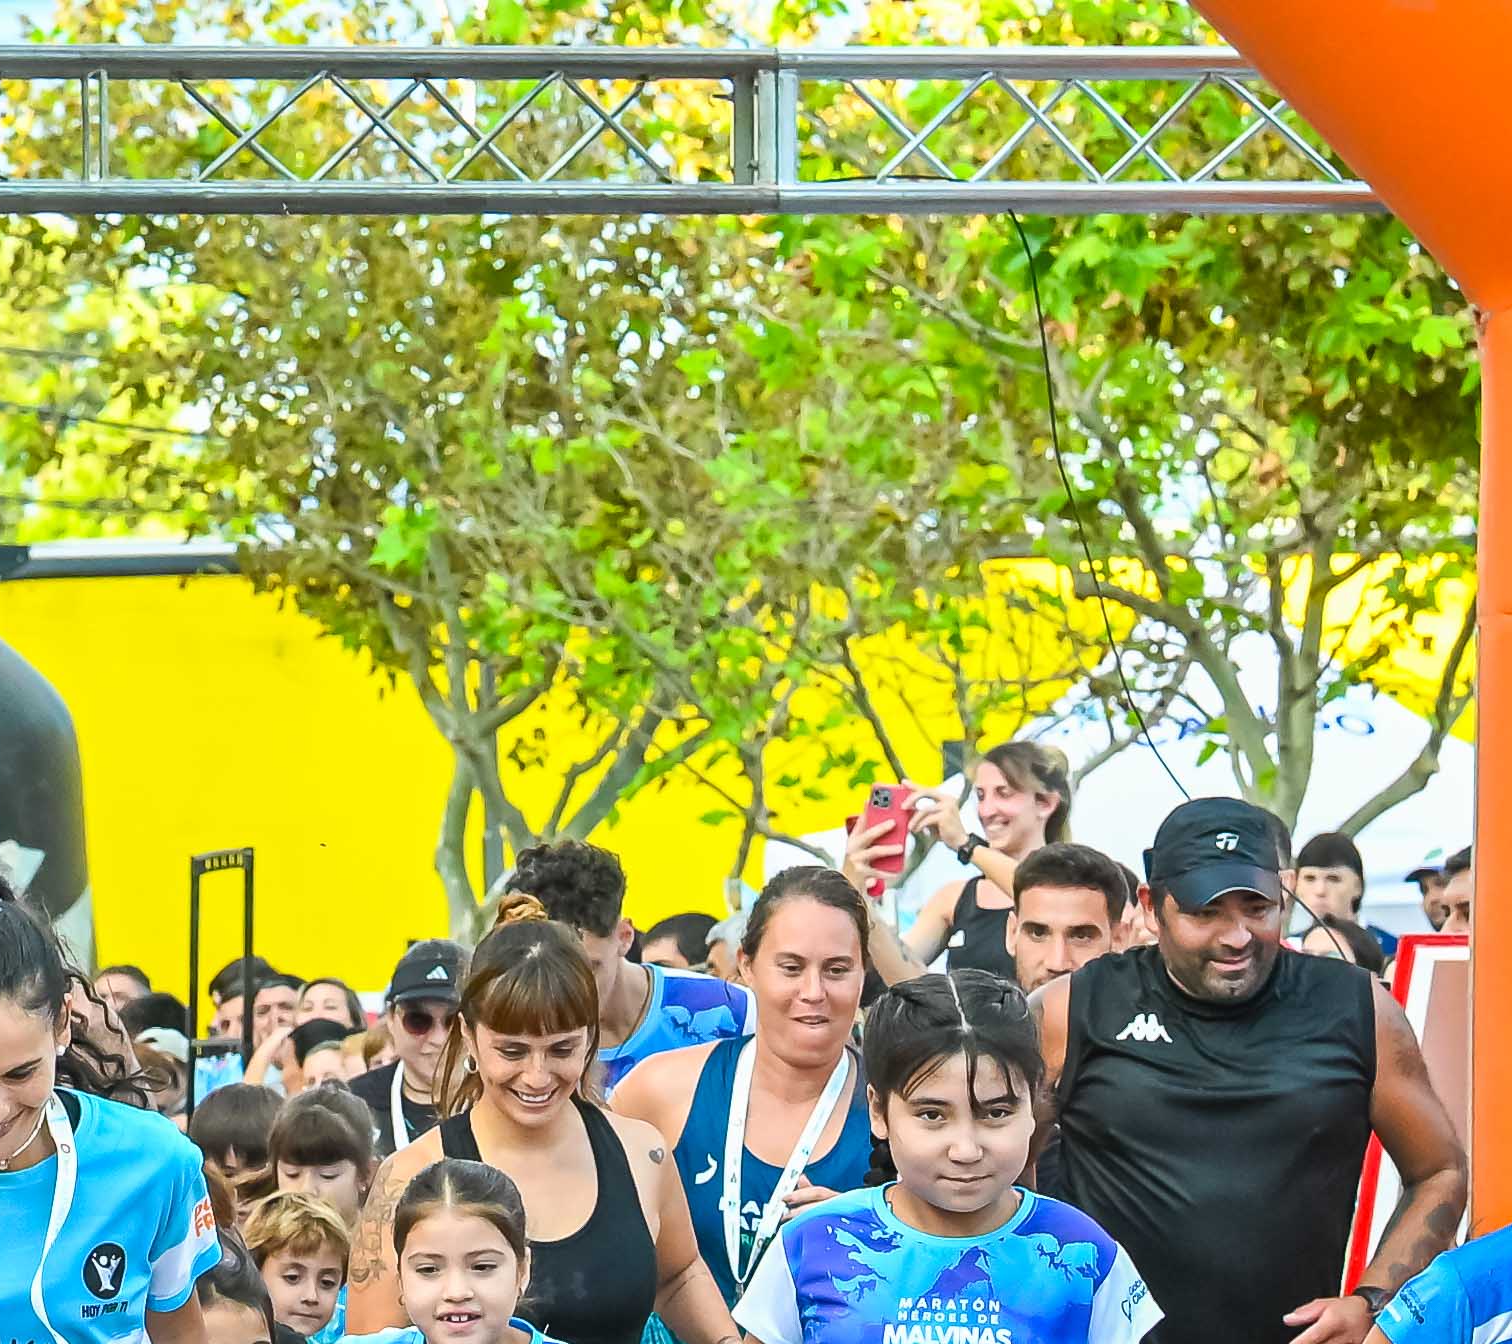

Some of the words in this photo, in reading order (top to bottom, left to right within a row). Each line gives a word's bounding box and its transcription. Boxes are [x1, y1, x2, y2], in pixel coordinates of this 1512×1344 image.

[81, 1303, 101, 1318] HOY
[898, 1297, 1001, 1312] MARATÓN
[897, 1310, 969, 1323] HÉROES
[977, 1313, 1000, 1325] DE
